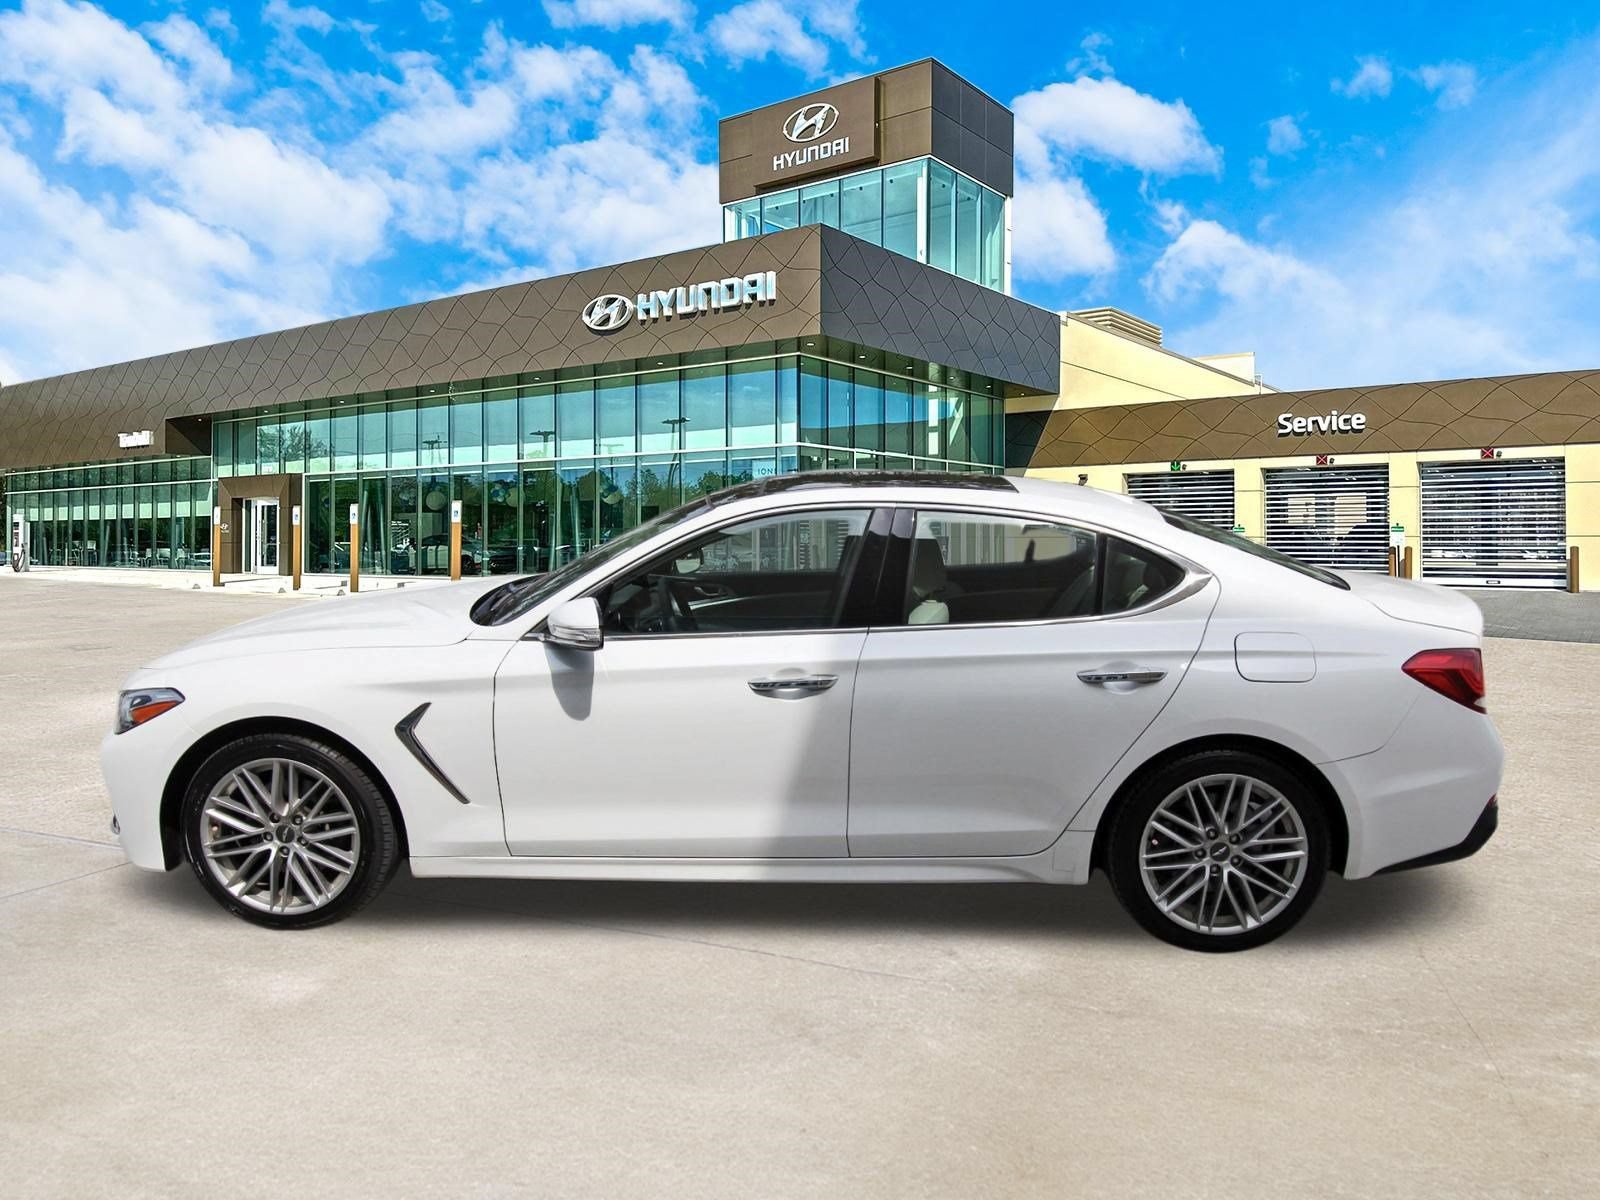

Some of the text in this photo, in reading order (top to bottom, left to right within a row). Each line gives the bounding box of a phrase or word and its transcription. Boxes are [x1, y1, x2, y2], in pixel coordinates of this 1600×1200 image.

[773, 137, 850, 171] HYUNDAI
[637, 270, 777, 321] HYUNDAI
[1277, 410, 1366, 434] Service
